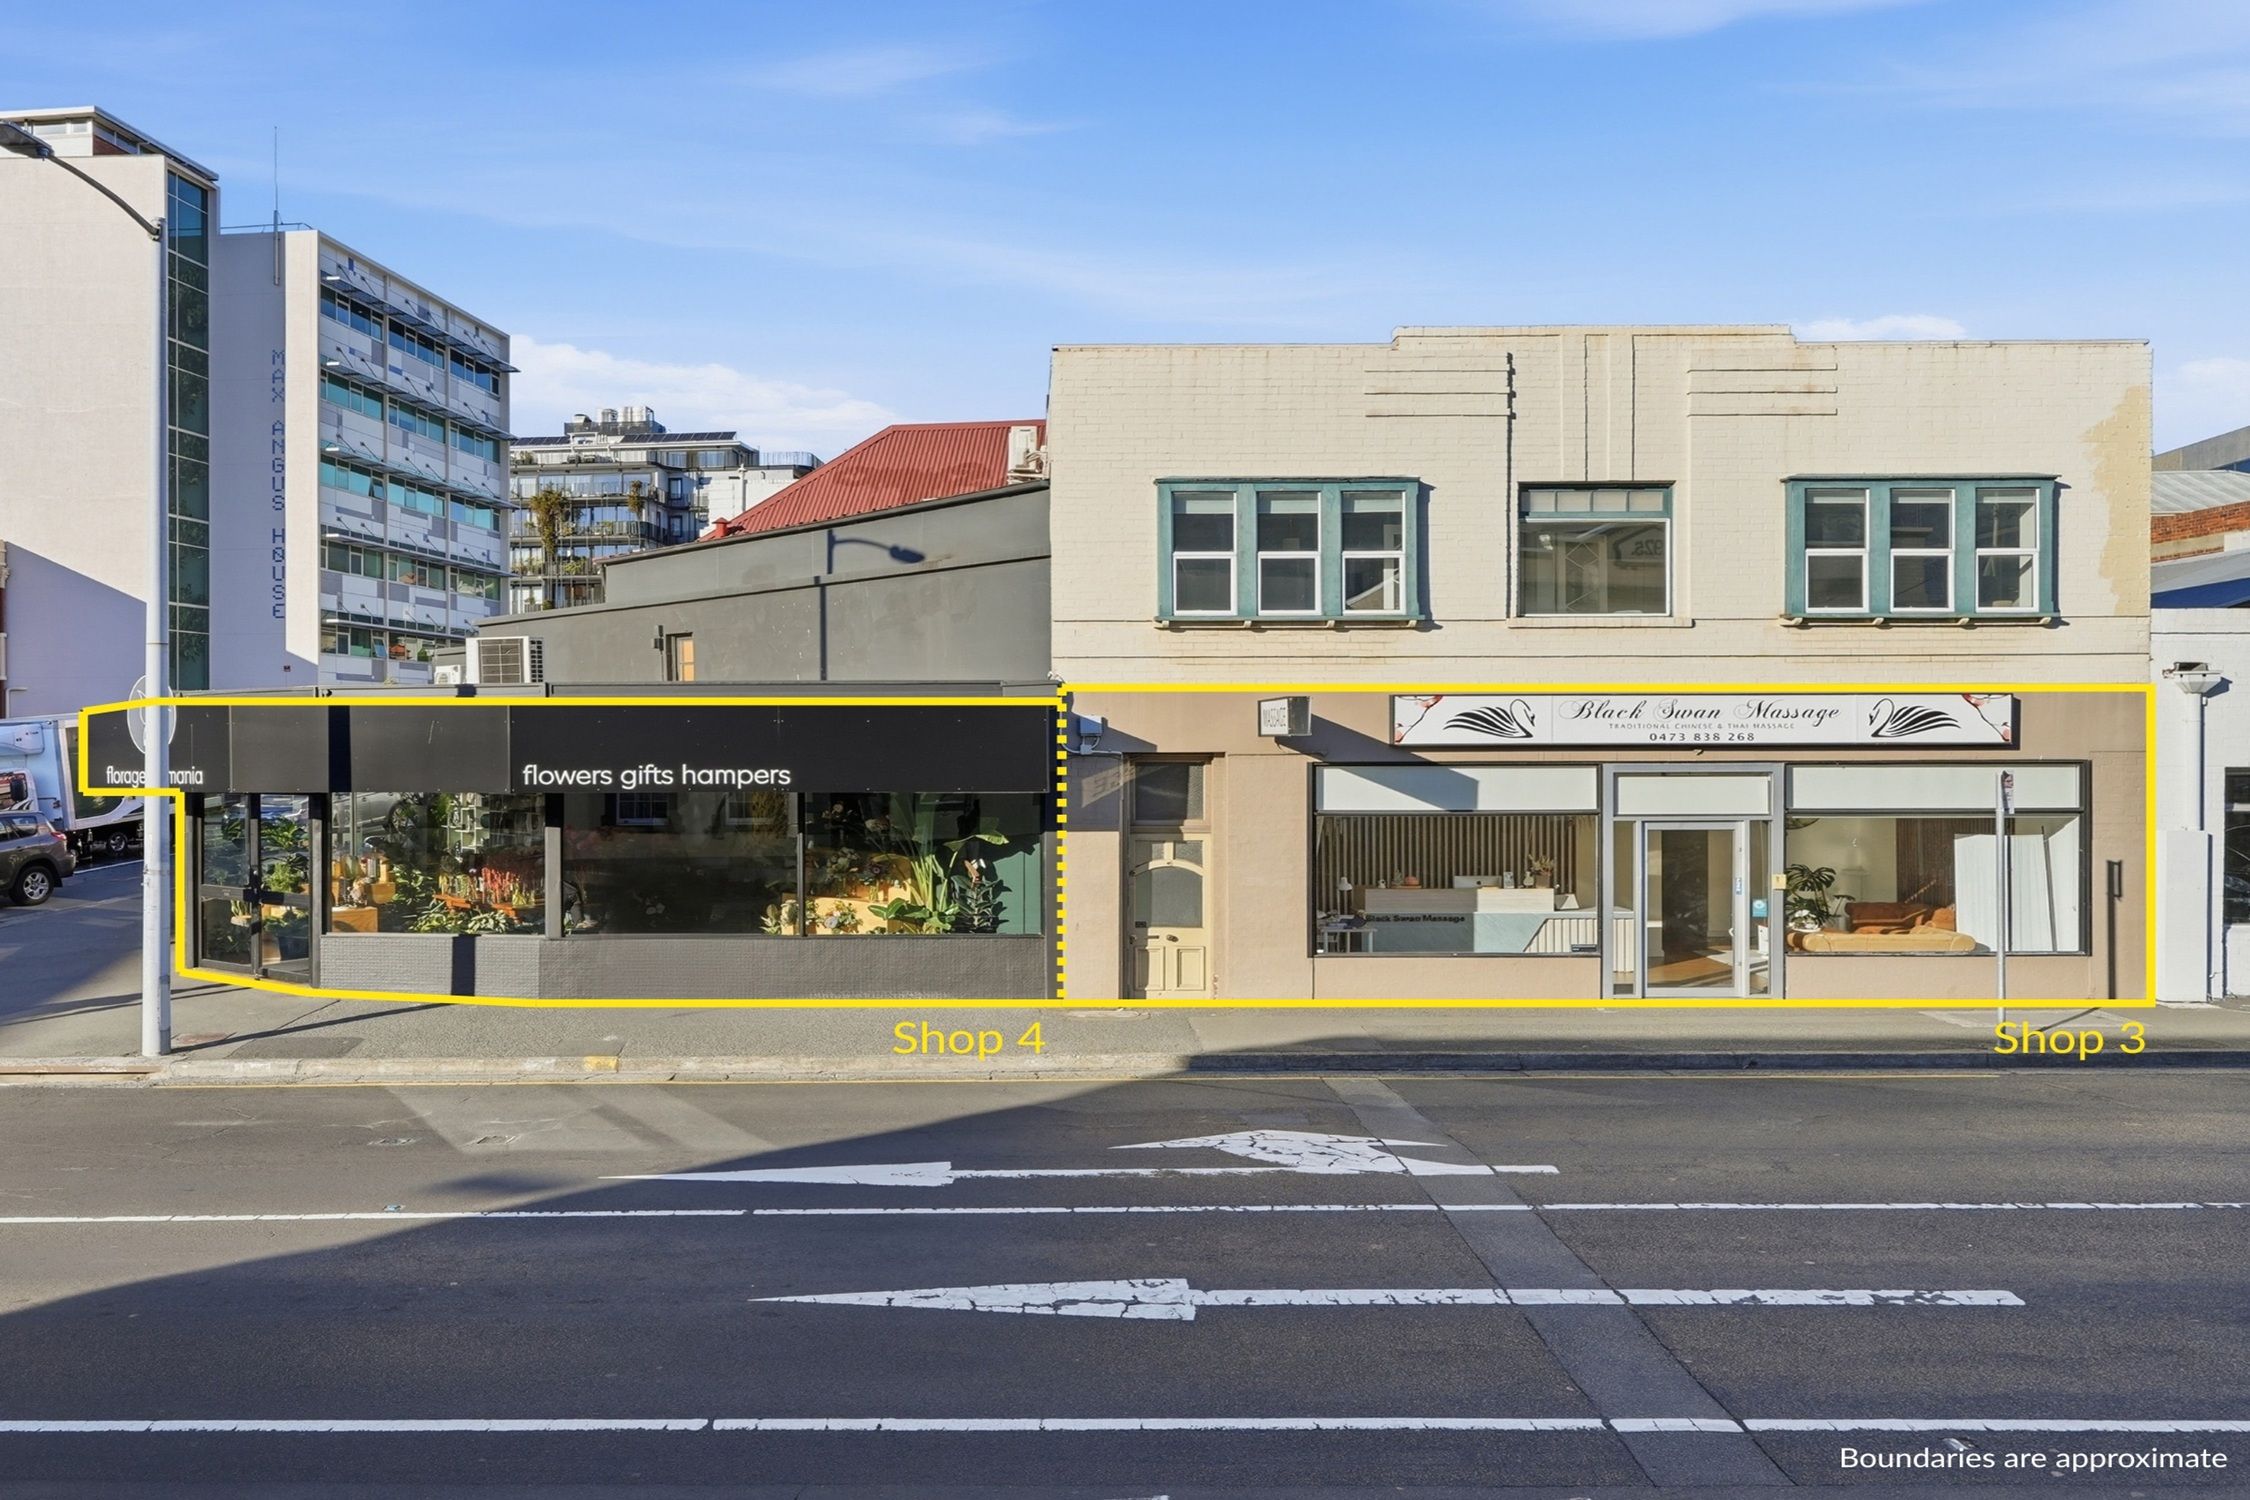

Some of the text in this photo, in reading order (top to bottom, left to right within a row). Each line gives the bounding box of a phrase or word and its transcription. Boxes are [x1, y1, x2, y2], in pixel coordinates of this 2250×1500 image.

[271, 349, 285, 403] MAX
[271, 420, 285, 511] ANGUS
[1558, 697, 1841, 728] Black Swan Massage
[1608, 722, 1671, 730] TRADITIONAL
[1674, 722, 1713, 730] CHINESE
[1727, 722, 1750, 730] THAI
[1752, 722, 1795, 730] MASSAGE
[1649, 732, 1755, 741] 0473 838 268
[522, 763, 792, 790] flowers gifts hampers
[1393, 914, 1421, 922] Swan
[1422, 914, 1466, 924] Massage
